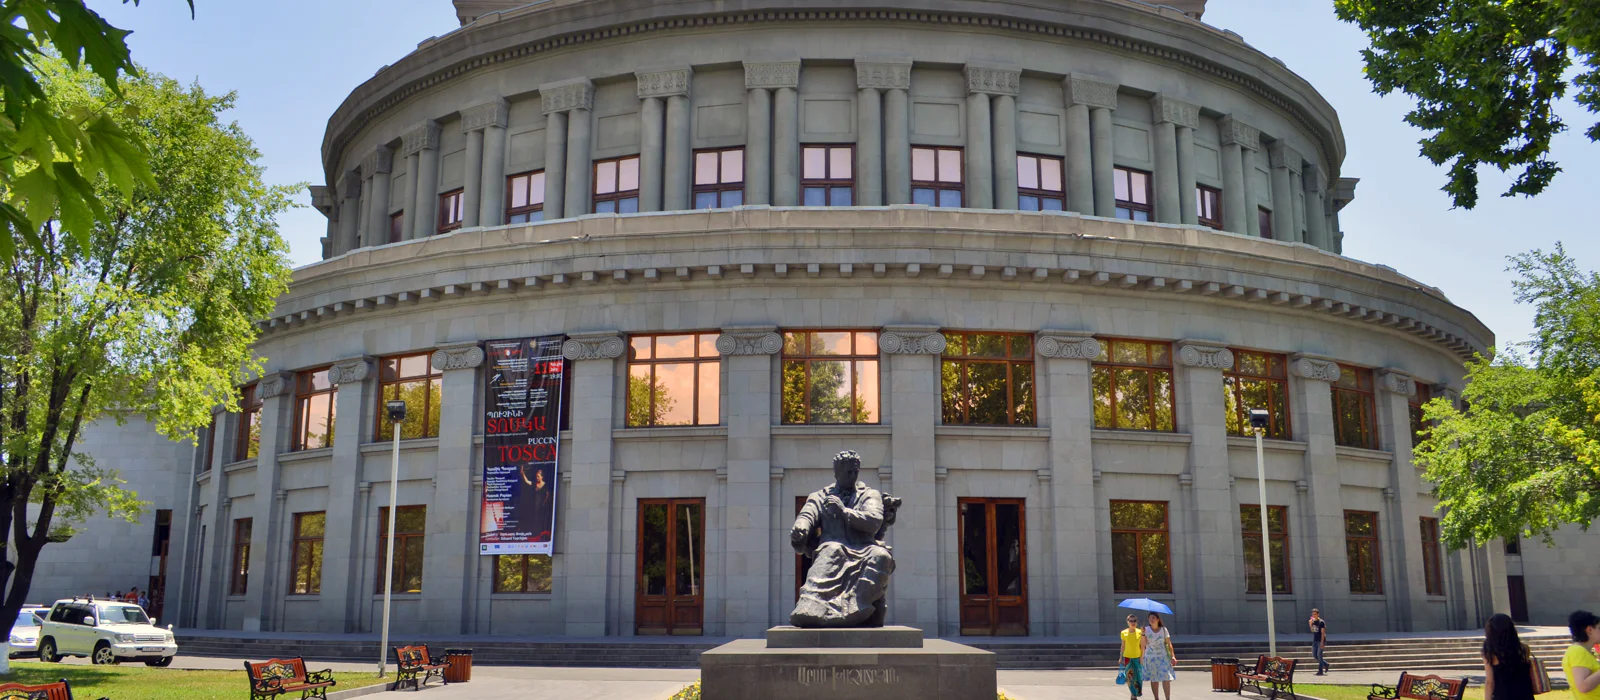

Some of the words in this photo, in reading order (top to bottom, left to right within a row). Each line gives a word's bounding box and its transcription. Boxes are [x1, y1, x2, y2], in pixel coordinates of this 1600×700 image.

[535, 362, 547, 375] 11
[487, 416, 546, 433] ՏՈՍԿԱ
[528, 437, 557, 445] PUCCIN
[498, 444, 556, 461] TOSCA
